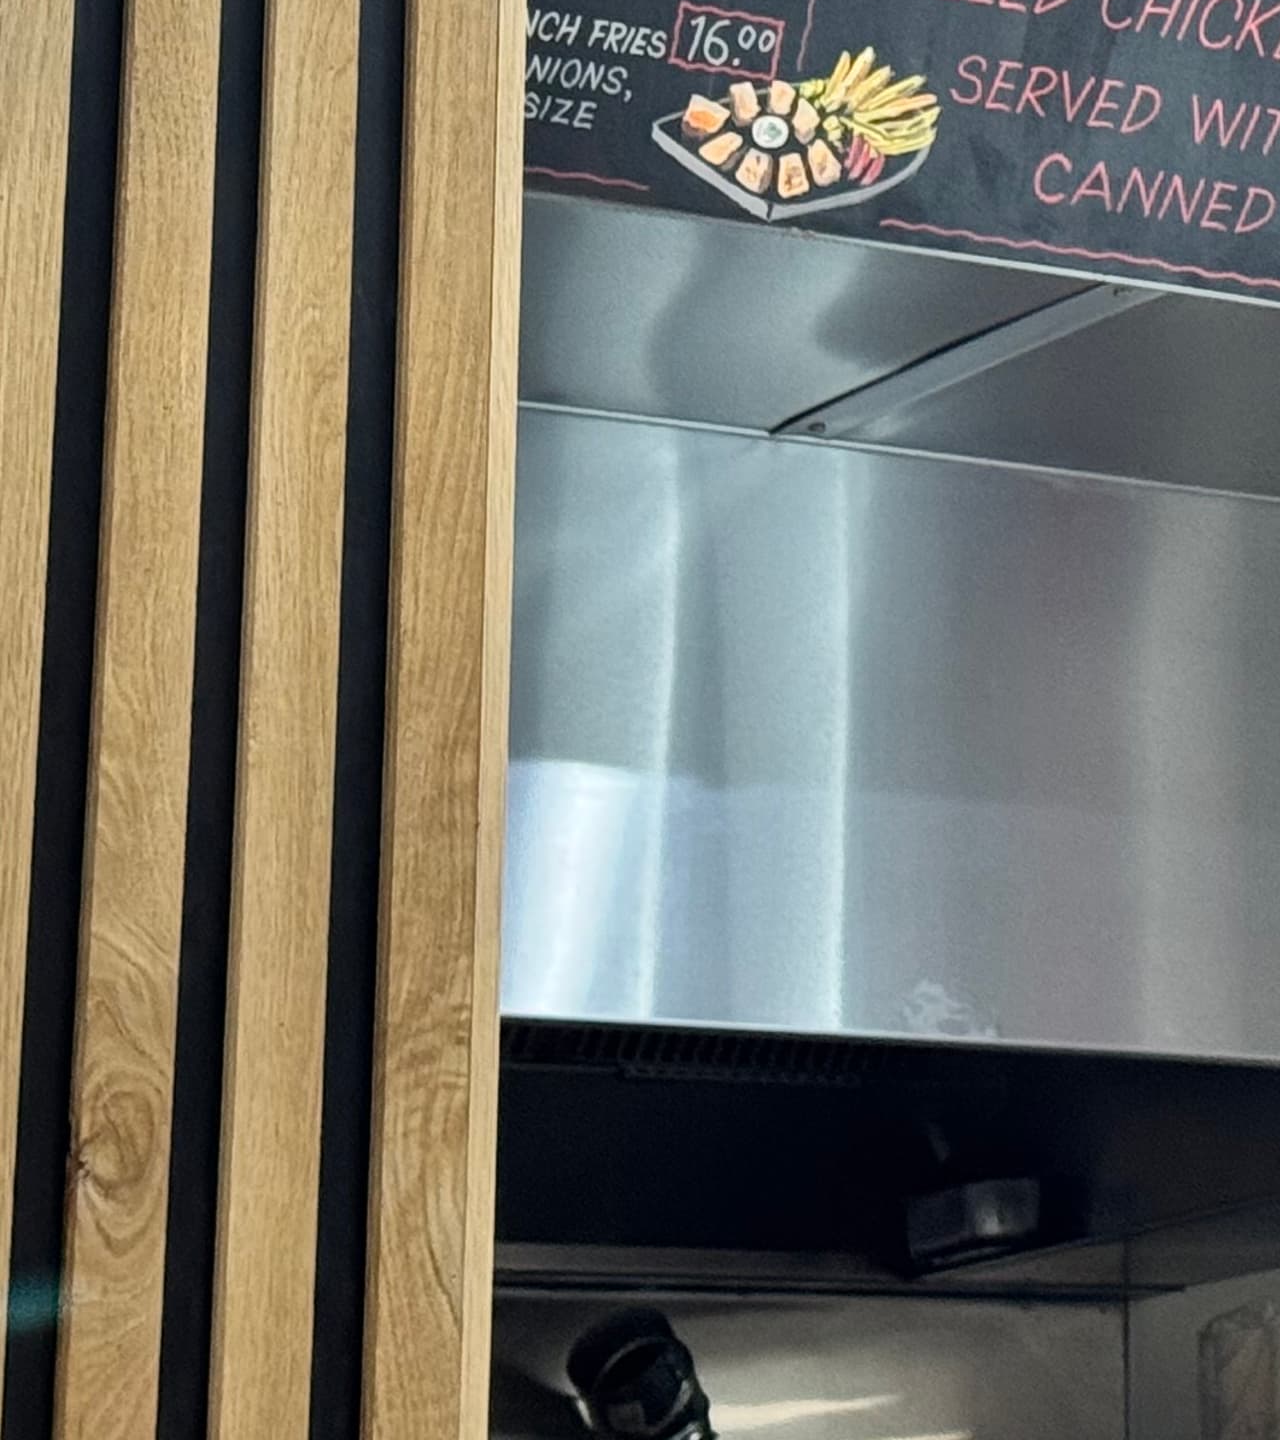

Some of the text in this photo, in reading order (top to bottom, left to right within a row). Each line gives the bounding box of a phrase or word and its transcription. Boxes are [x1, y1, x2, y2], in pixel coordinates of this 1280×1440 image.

[586, 18, 668, 60] FRIES
[949, 53, 1163, 135] SERVED
[1032, 151, 1277, 234] CANNED
